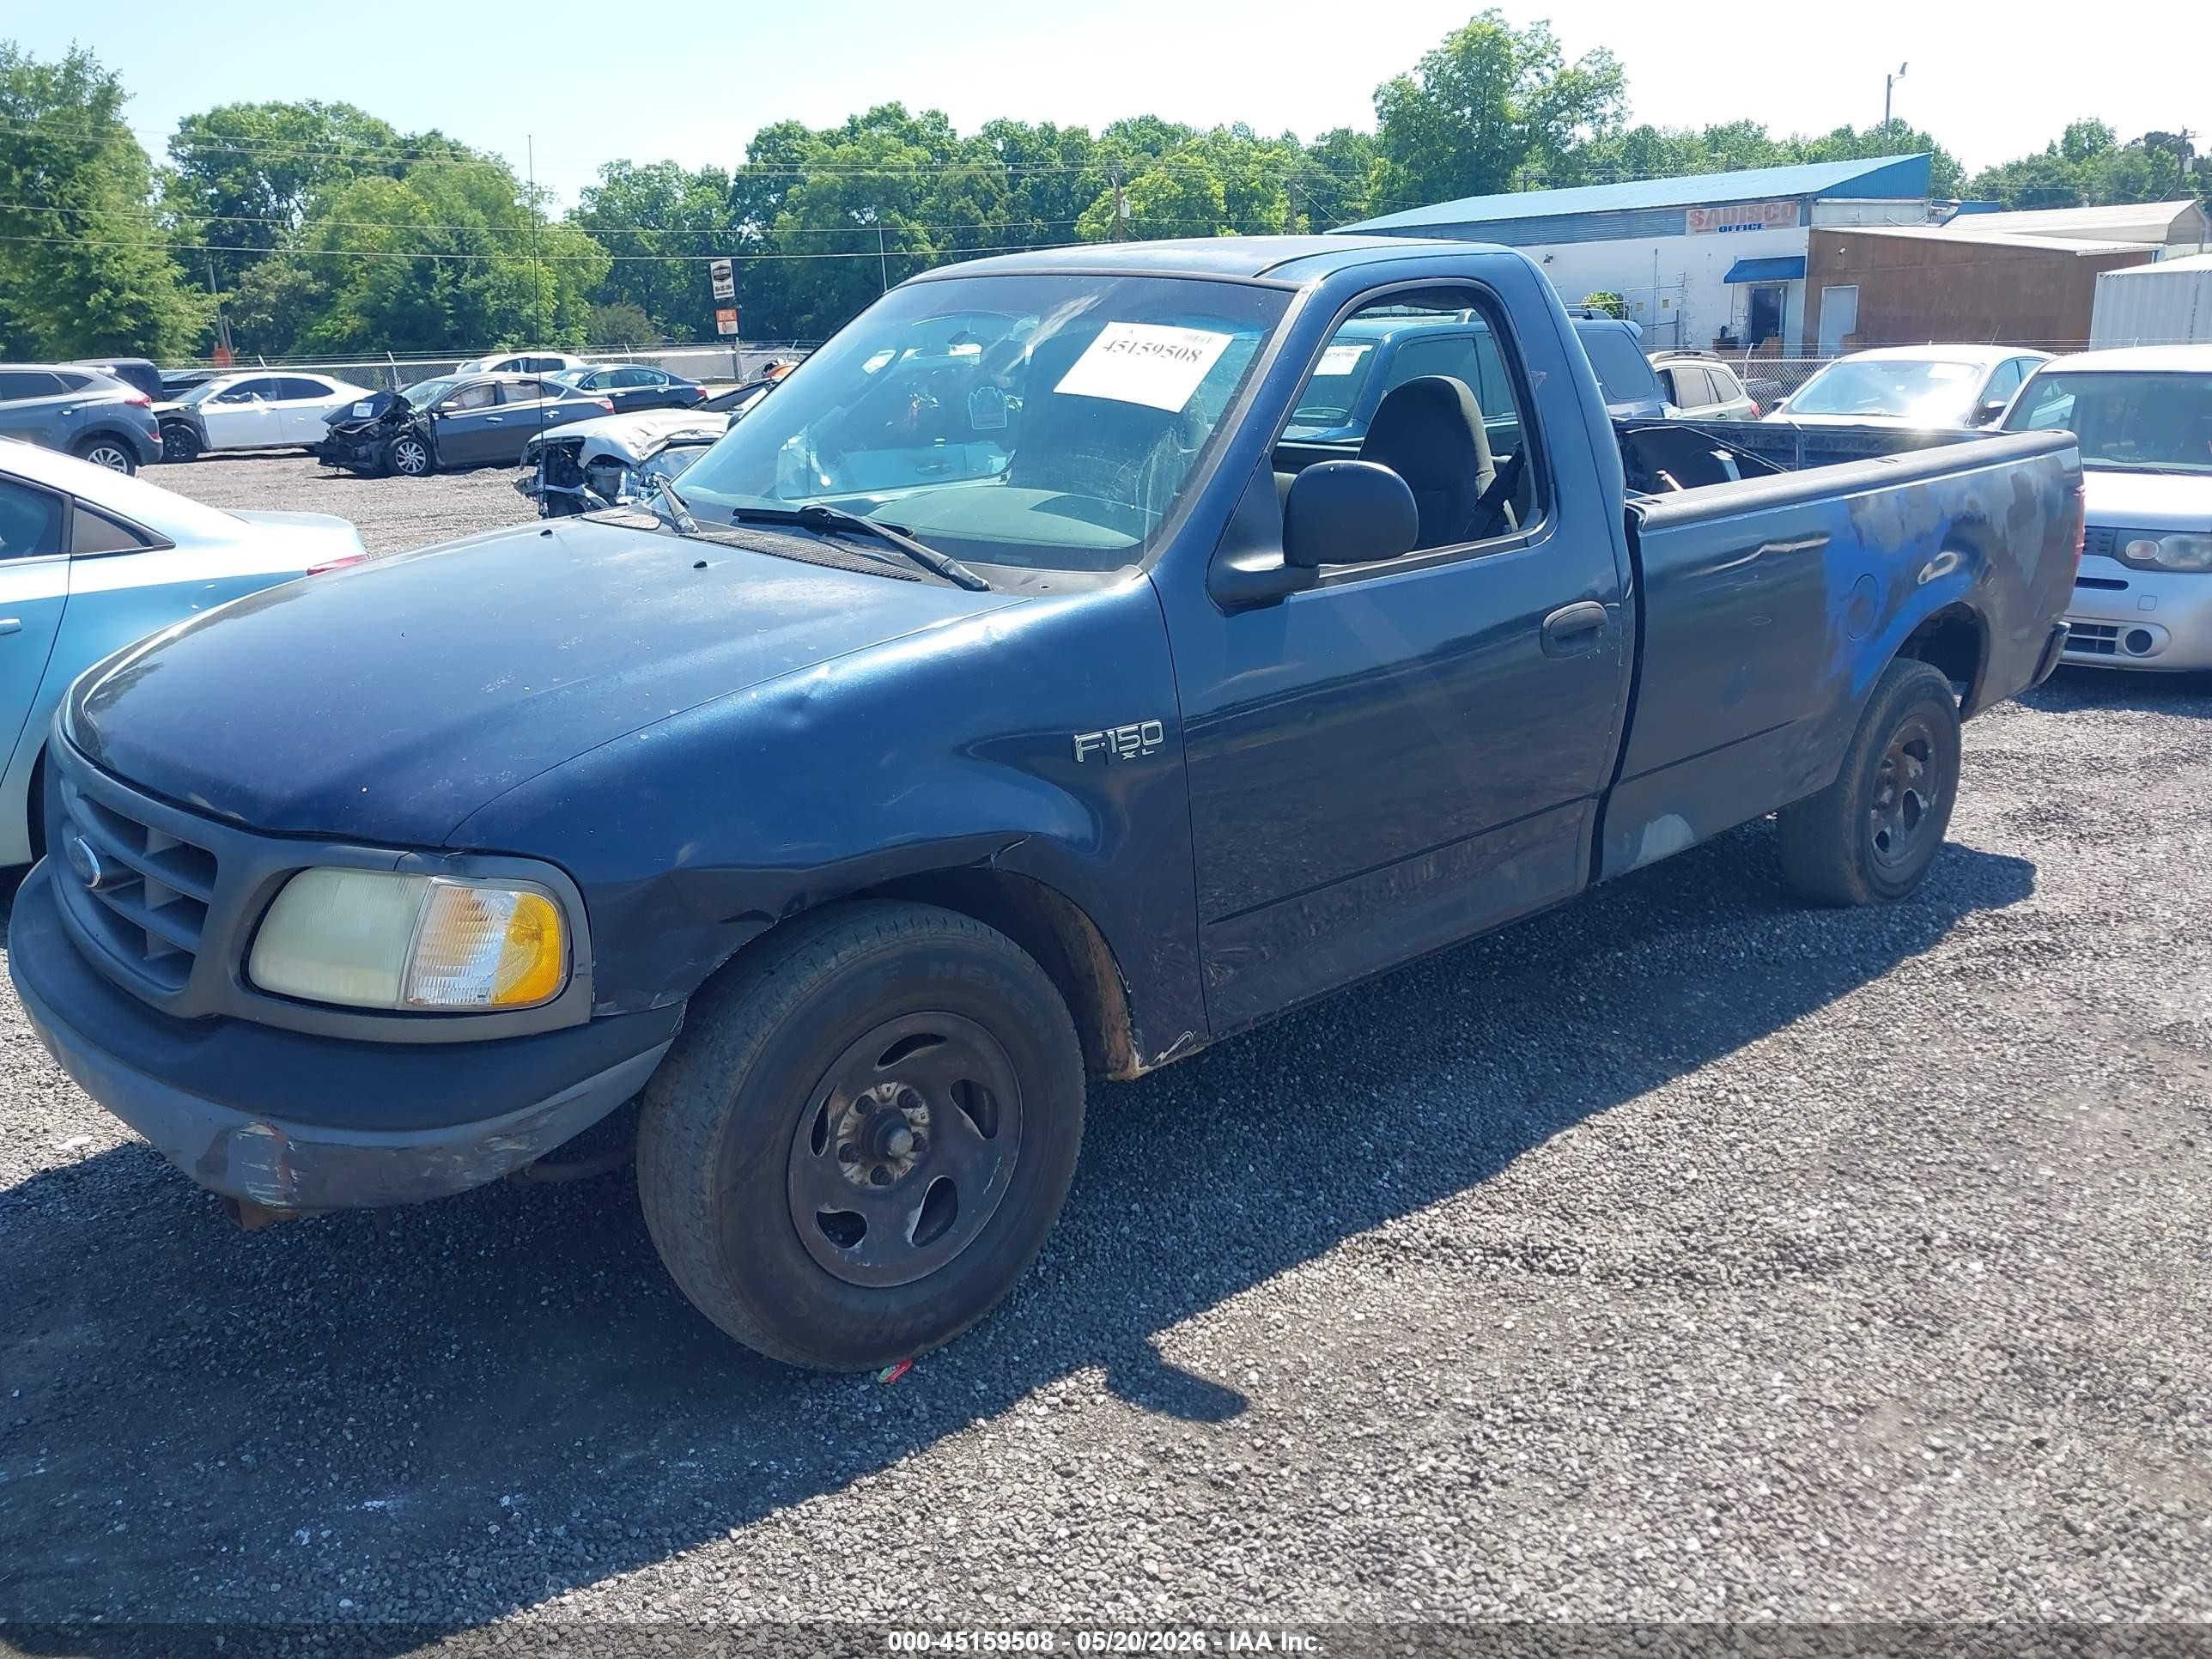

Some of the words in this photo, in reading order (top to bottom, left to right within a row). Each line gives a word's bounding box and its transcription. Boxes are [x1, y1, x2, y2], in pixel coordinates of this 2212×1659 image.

[1690, 203, 1797, 227] SADISCO
[1719, 222, 1766, 233] OFFICE
[1103, 339, 1202, 362] 45159508
[1074, 720, 1164, 763] F-150
[1121, 749, 1155, 760] XL
